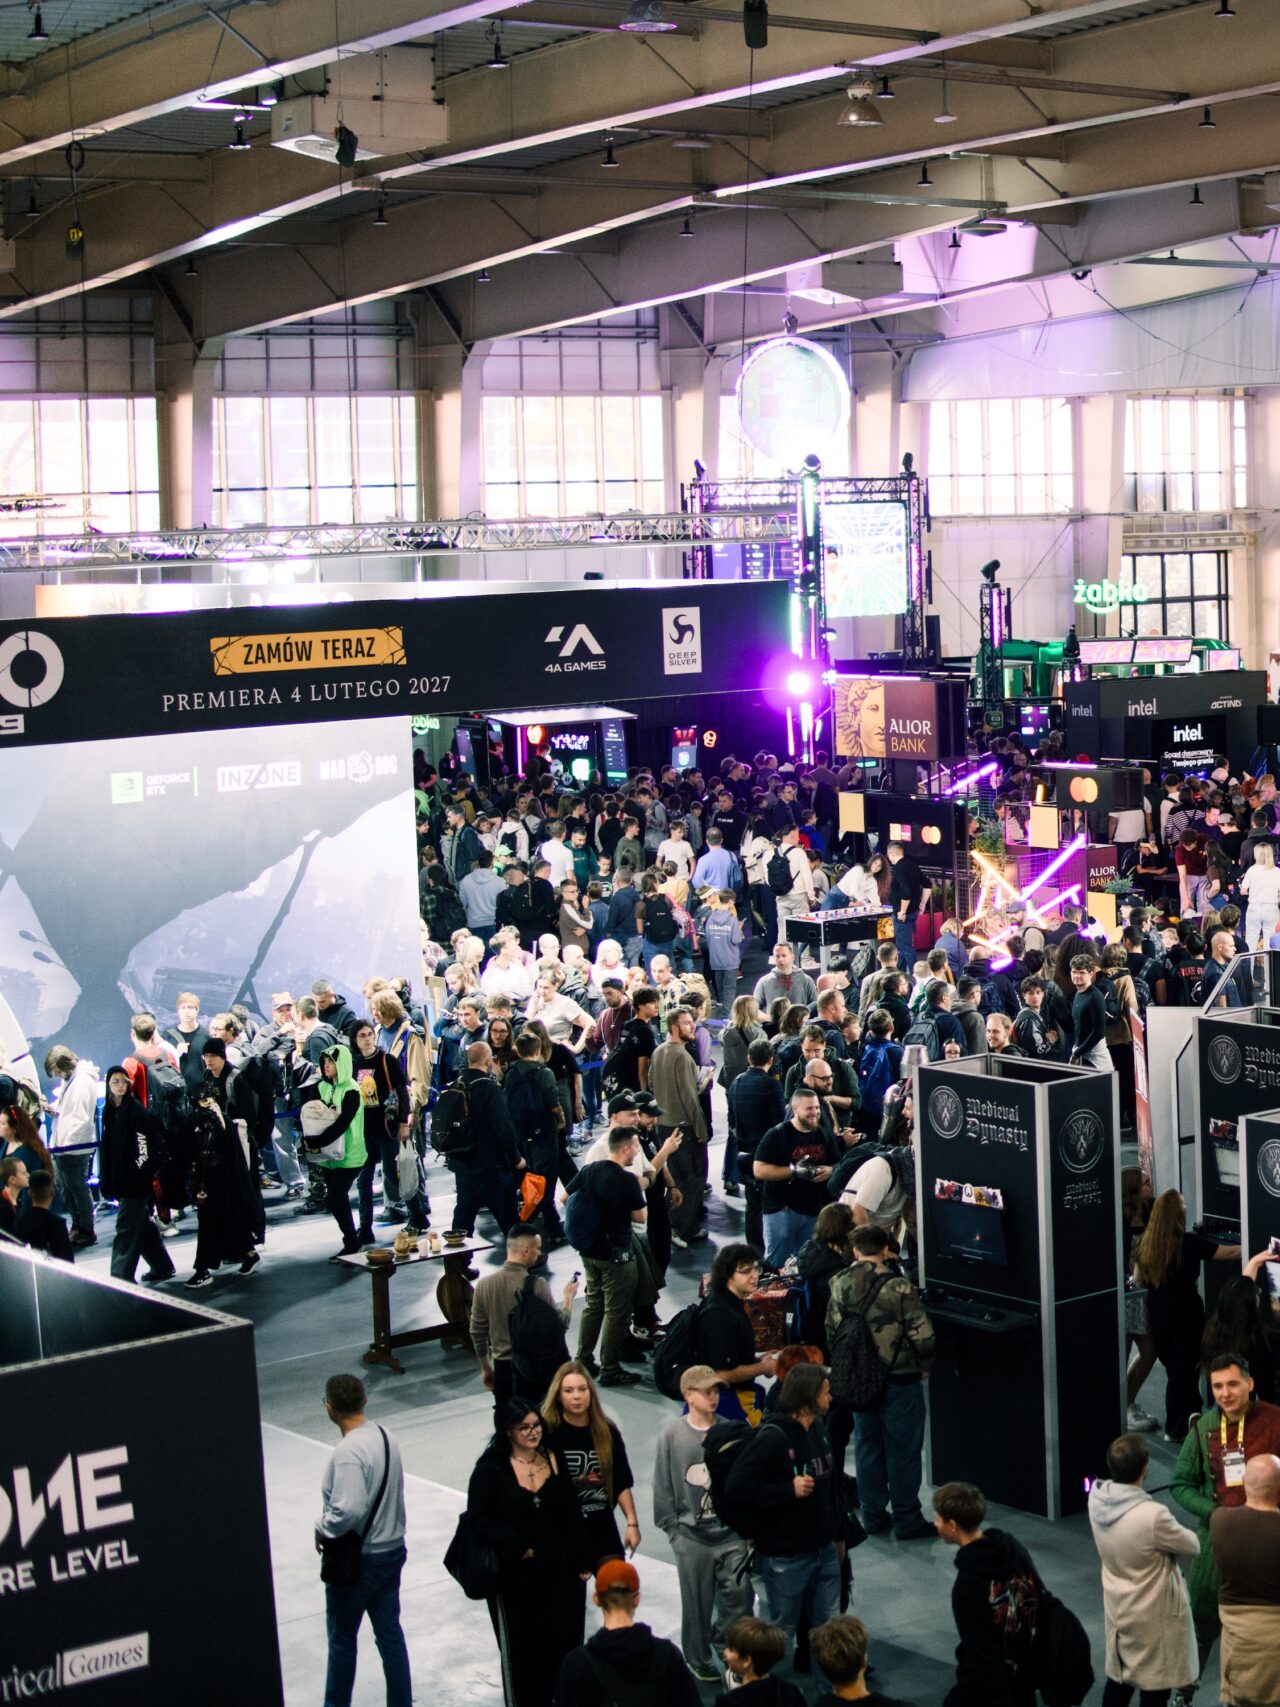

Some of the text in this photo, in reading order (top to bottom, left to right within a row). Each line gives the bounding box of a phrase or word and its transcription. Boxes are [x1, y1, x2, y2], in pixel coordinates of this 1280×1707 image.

[1073, 579, 1148, 603] żabka
[243, 636, 377, 666] ZAMÓW TERAZ
[668, 651, 697, 660] DEEP
[668, 658, 697, 667] SILVER
[544, 660, 607, 673] 4A GAMES
[162, 675, 452, 712] PREMIERA 4 LUTEGO 2027
[889, 718, 932, 735] ALIOR
[891, 737, 926, 753] BANK
[146, 772, 190, 785] GEFORCE
[220, 763, 299, 789] INZONE
[320, 754, 398, 781] MAD DOG
[146, 785, 166, 796] RTX
[1089, 865, 1116, 877] ALIOR
[966, 1097, 1020, 1123] Medieval
[965, 1117, 1029, 1152] Dynasty
[50, 1539, 140, 1582] LEVEL
[68, 1643, 144, 1678] Games
